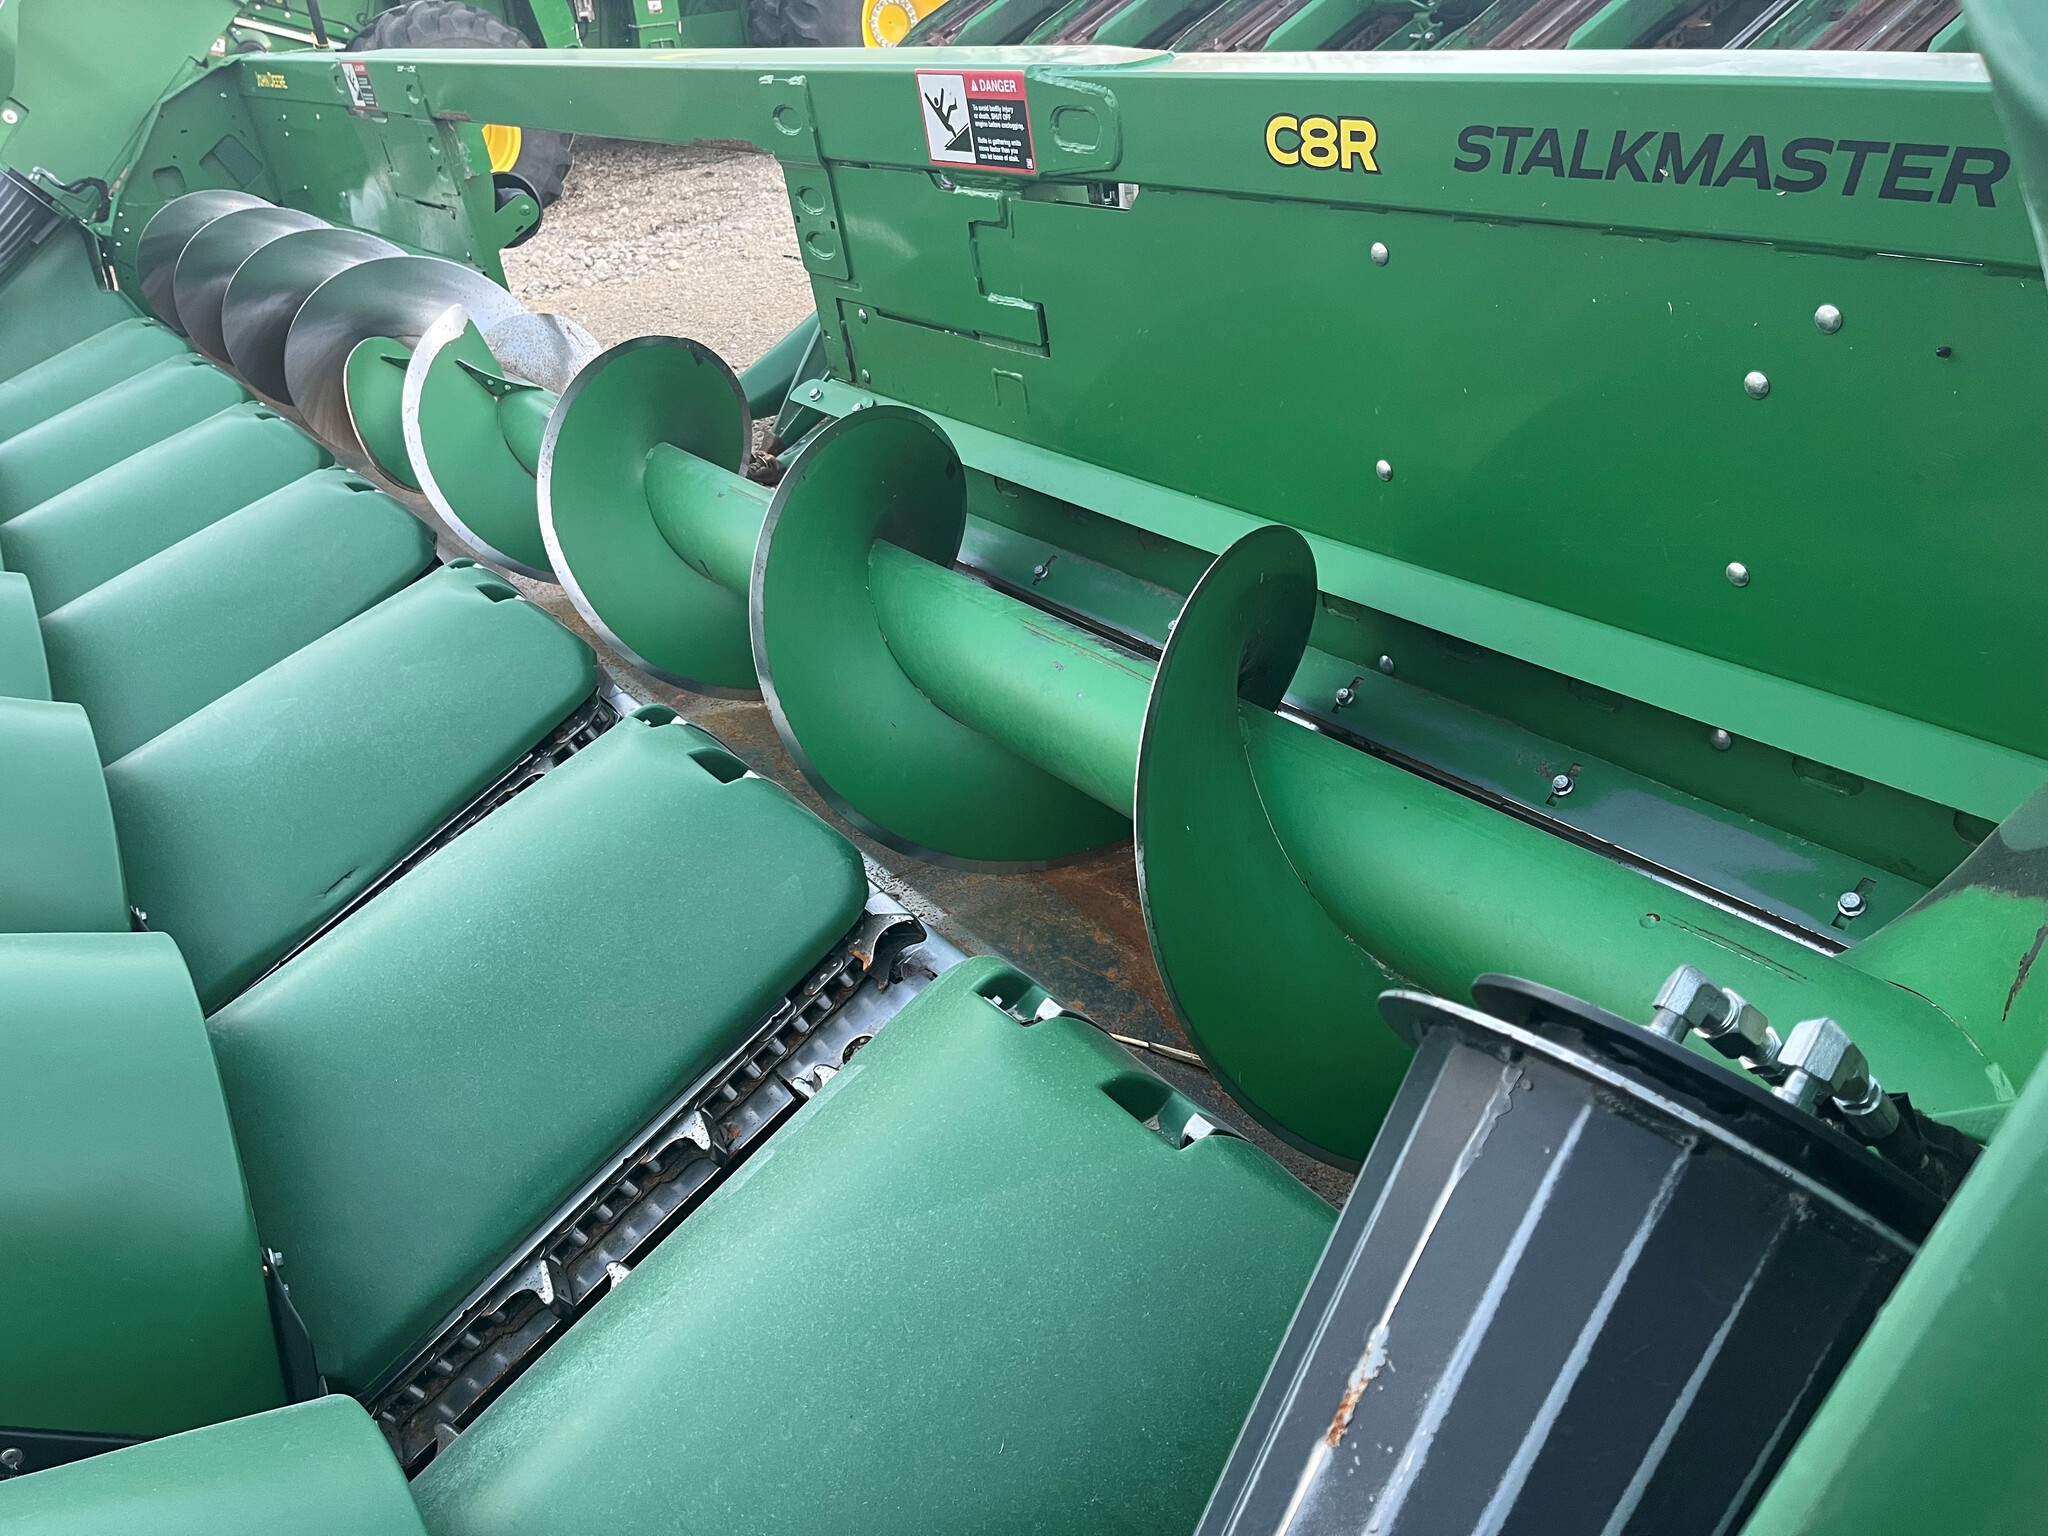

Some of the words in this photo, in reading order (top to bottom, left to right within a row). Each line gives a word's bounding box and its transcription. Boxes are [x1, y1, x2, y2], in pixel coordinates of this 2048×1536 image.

[979, 79, 1016, 93] DANGER
[1002, 105, 1013, 114] injury
[991, 112, 1002, 120] SHUT
[1265, 113, 1381, 174] C8R
[1453, 124, 2012, 208] STALKMASTER
